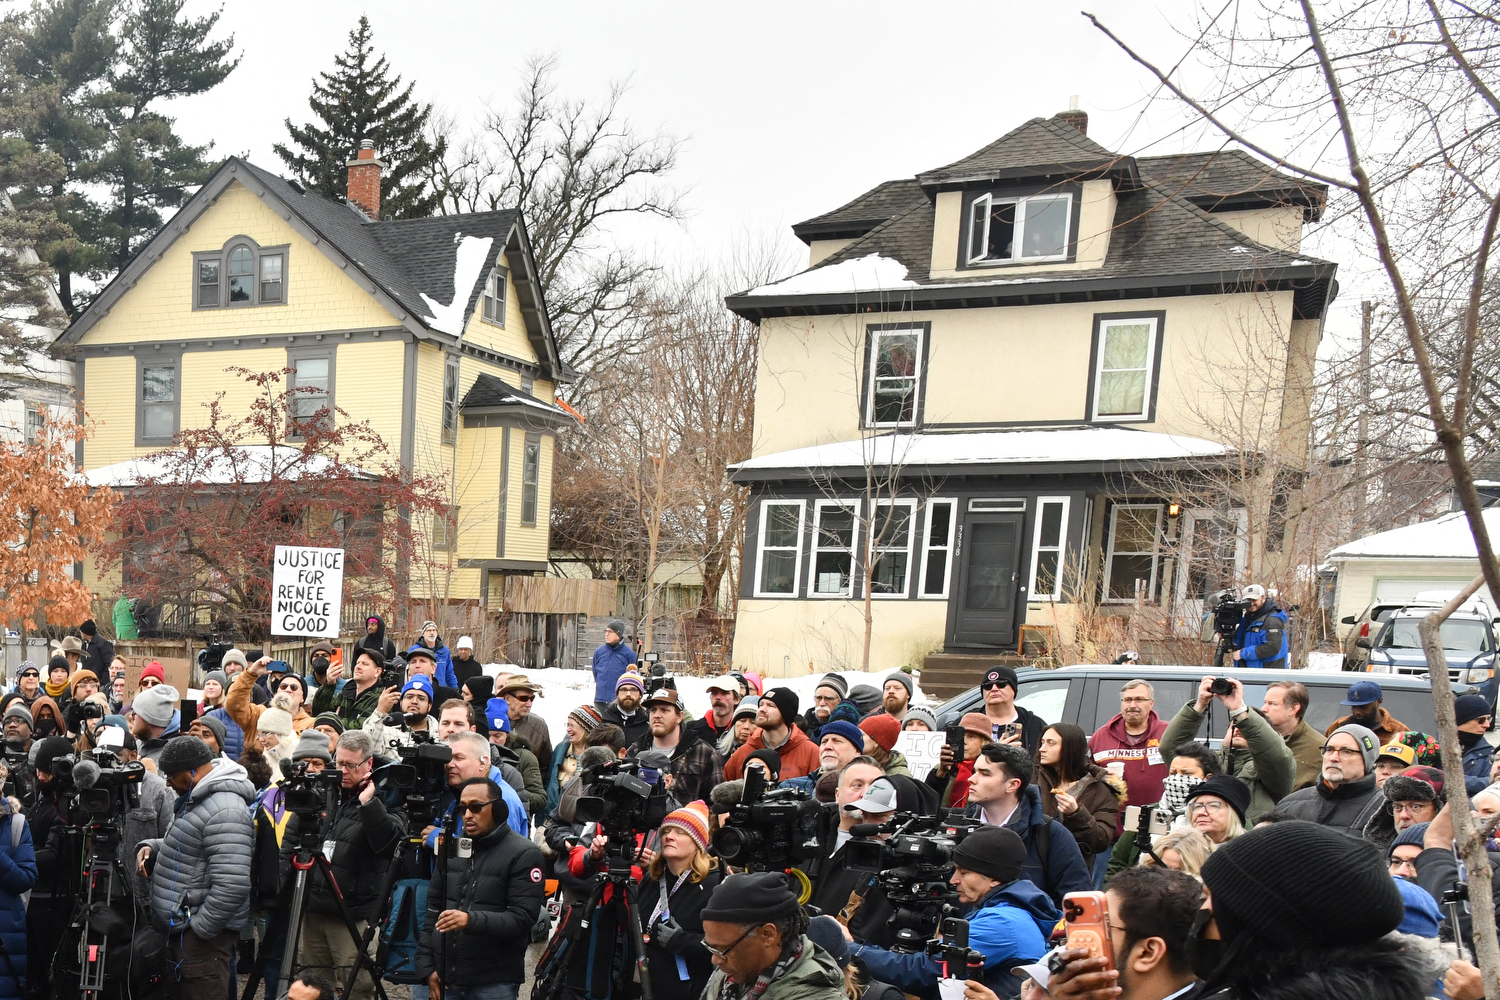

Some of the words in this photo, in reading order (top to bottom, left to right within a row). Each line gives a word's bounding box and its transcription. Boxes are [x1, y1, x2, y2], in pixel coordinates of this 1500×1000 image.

[278, 549, 341, 569] JUSTICE
[298, 569, 324, 584] FOR
[278, 584, 325, 600] RENEE
[277, 600, 331, 616] NICOLE
[282, 614, 327, 632] GOOD
